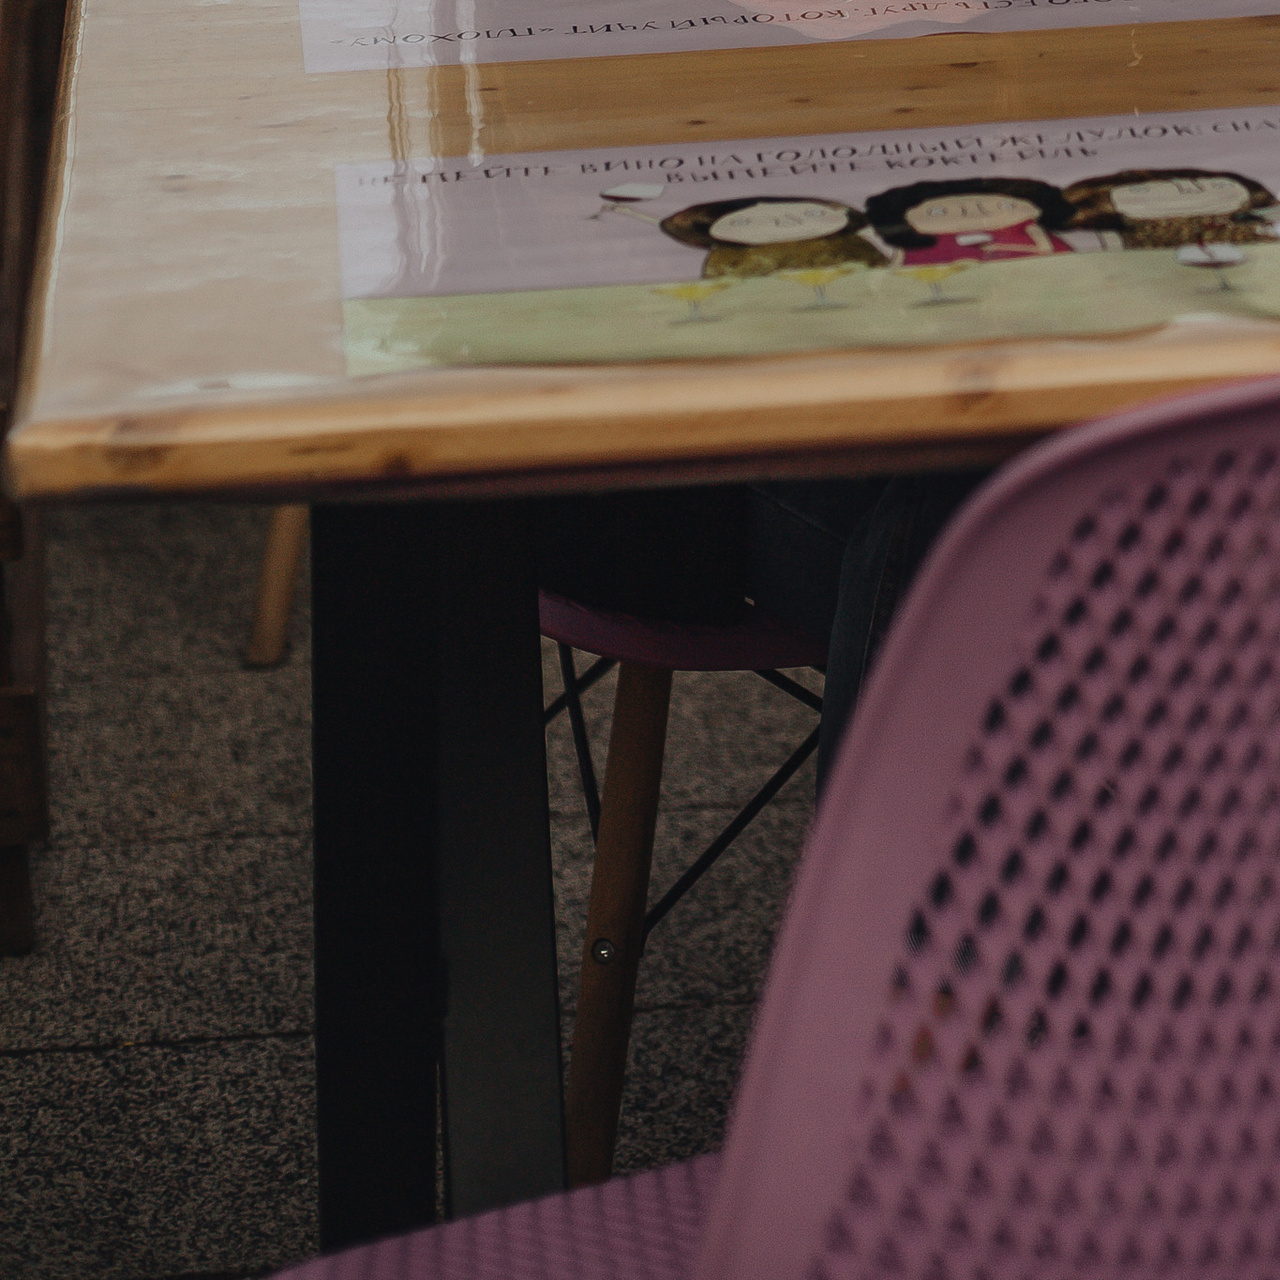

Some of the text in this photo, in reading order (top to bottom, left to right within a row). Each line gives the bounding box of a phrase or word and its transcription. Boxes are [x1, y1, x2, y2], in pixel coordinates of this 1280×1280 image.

[564, 20, 661, 35] УЧИТ
[670, 9, 847, 30] КОТОРЫЙ
[329, 26, 555, 47] «ПЛОХОМУ»
[420, 165, 562, 185] ПЕЙТЕ
[580, 157, 685, 175] ВИНО
[697, 153, 743, 167] НА
[756, 134, 984, 164] ГОЛОДНЫЙ
[665, 146, 1098, 184] ВЫПЕЙТЕ КОКТЕЙЛЬ
